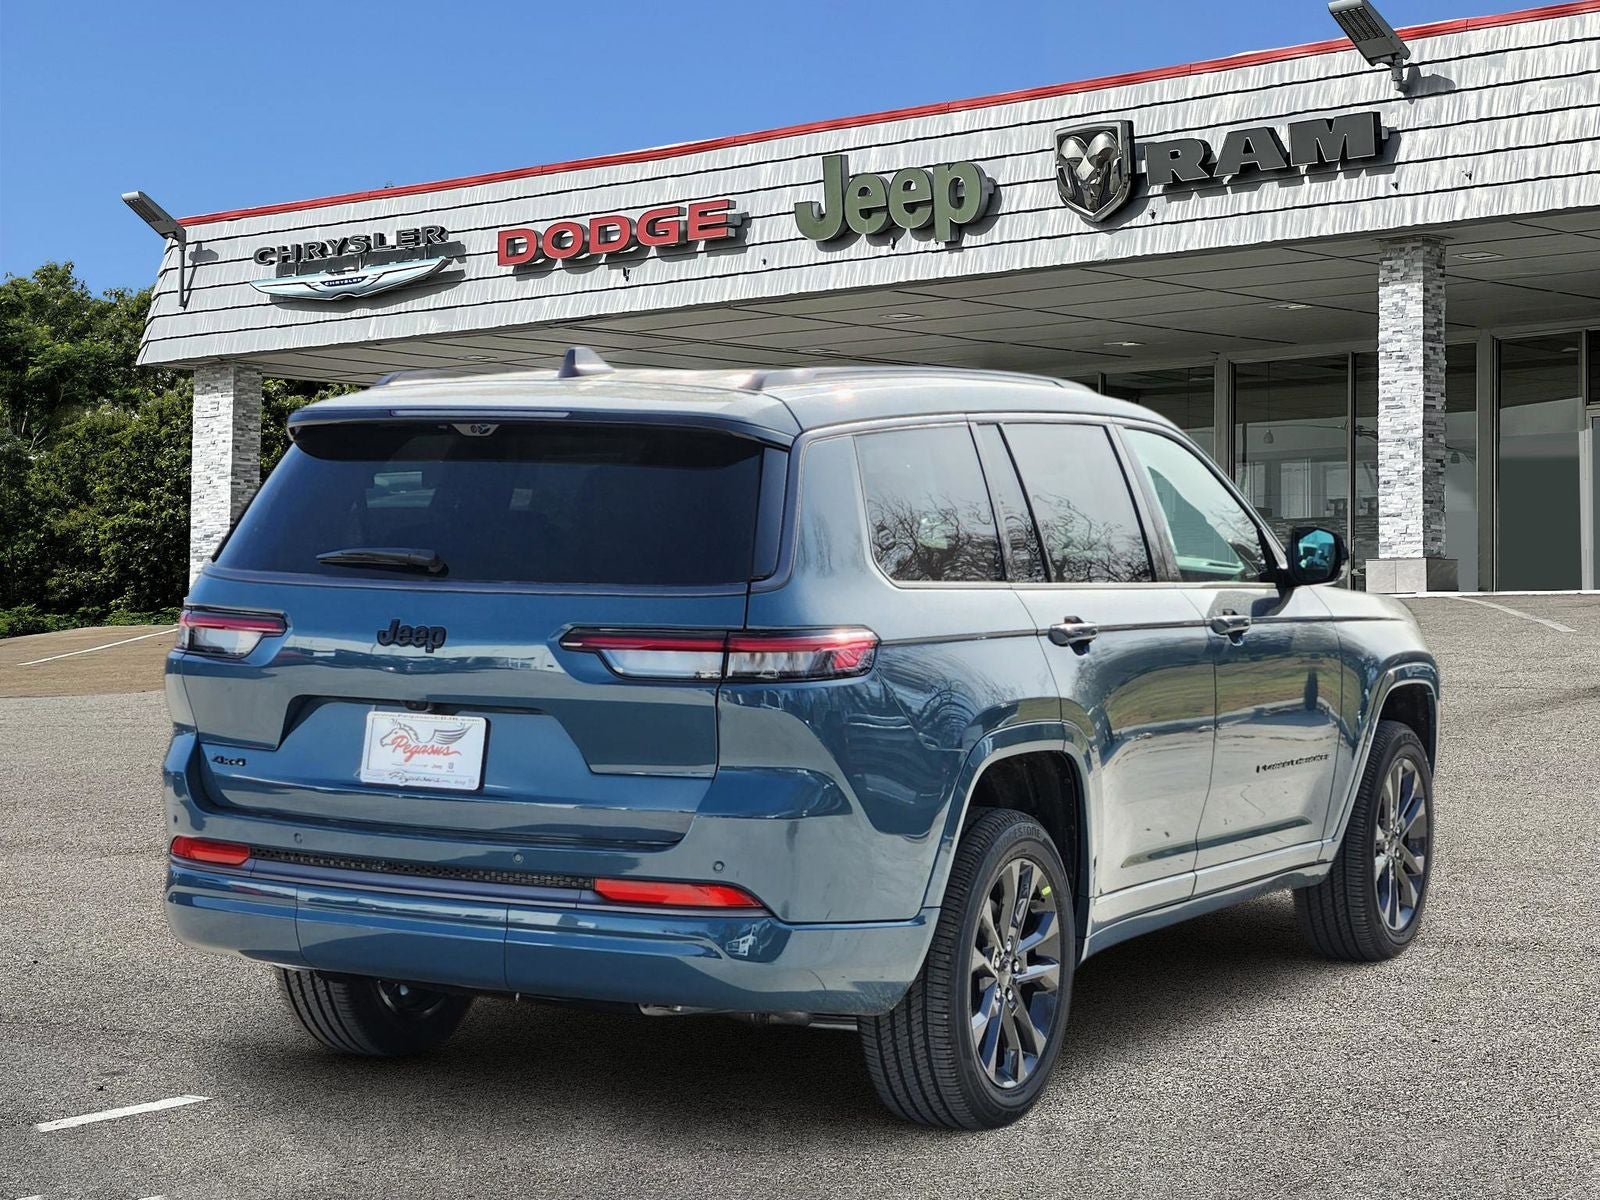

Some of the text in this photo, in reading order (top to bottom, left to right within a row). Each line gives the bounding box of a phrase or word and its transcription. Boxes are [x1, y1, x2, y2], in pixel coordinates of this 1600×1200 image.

[1145, 111, 1379, 186] RAM
[794, 154, 986, 242] Jeep
[253, 225, 449, 266] CHRYSLER
[497, 199, 733, 267] DODGE
[377, 618, 447, 653] Jeep
[391, 735, 462, 763] Pegasus
